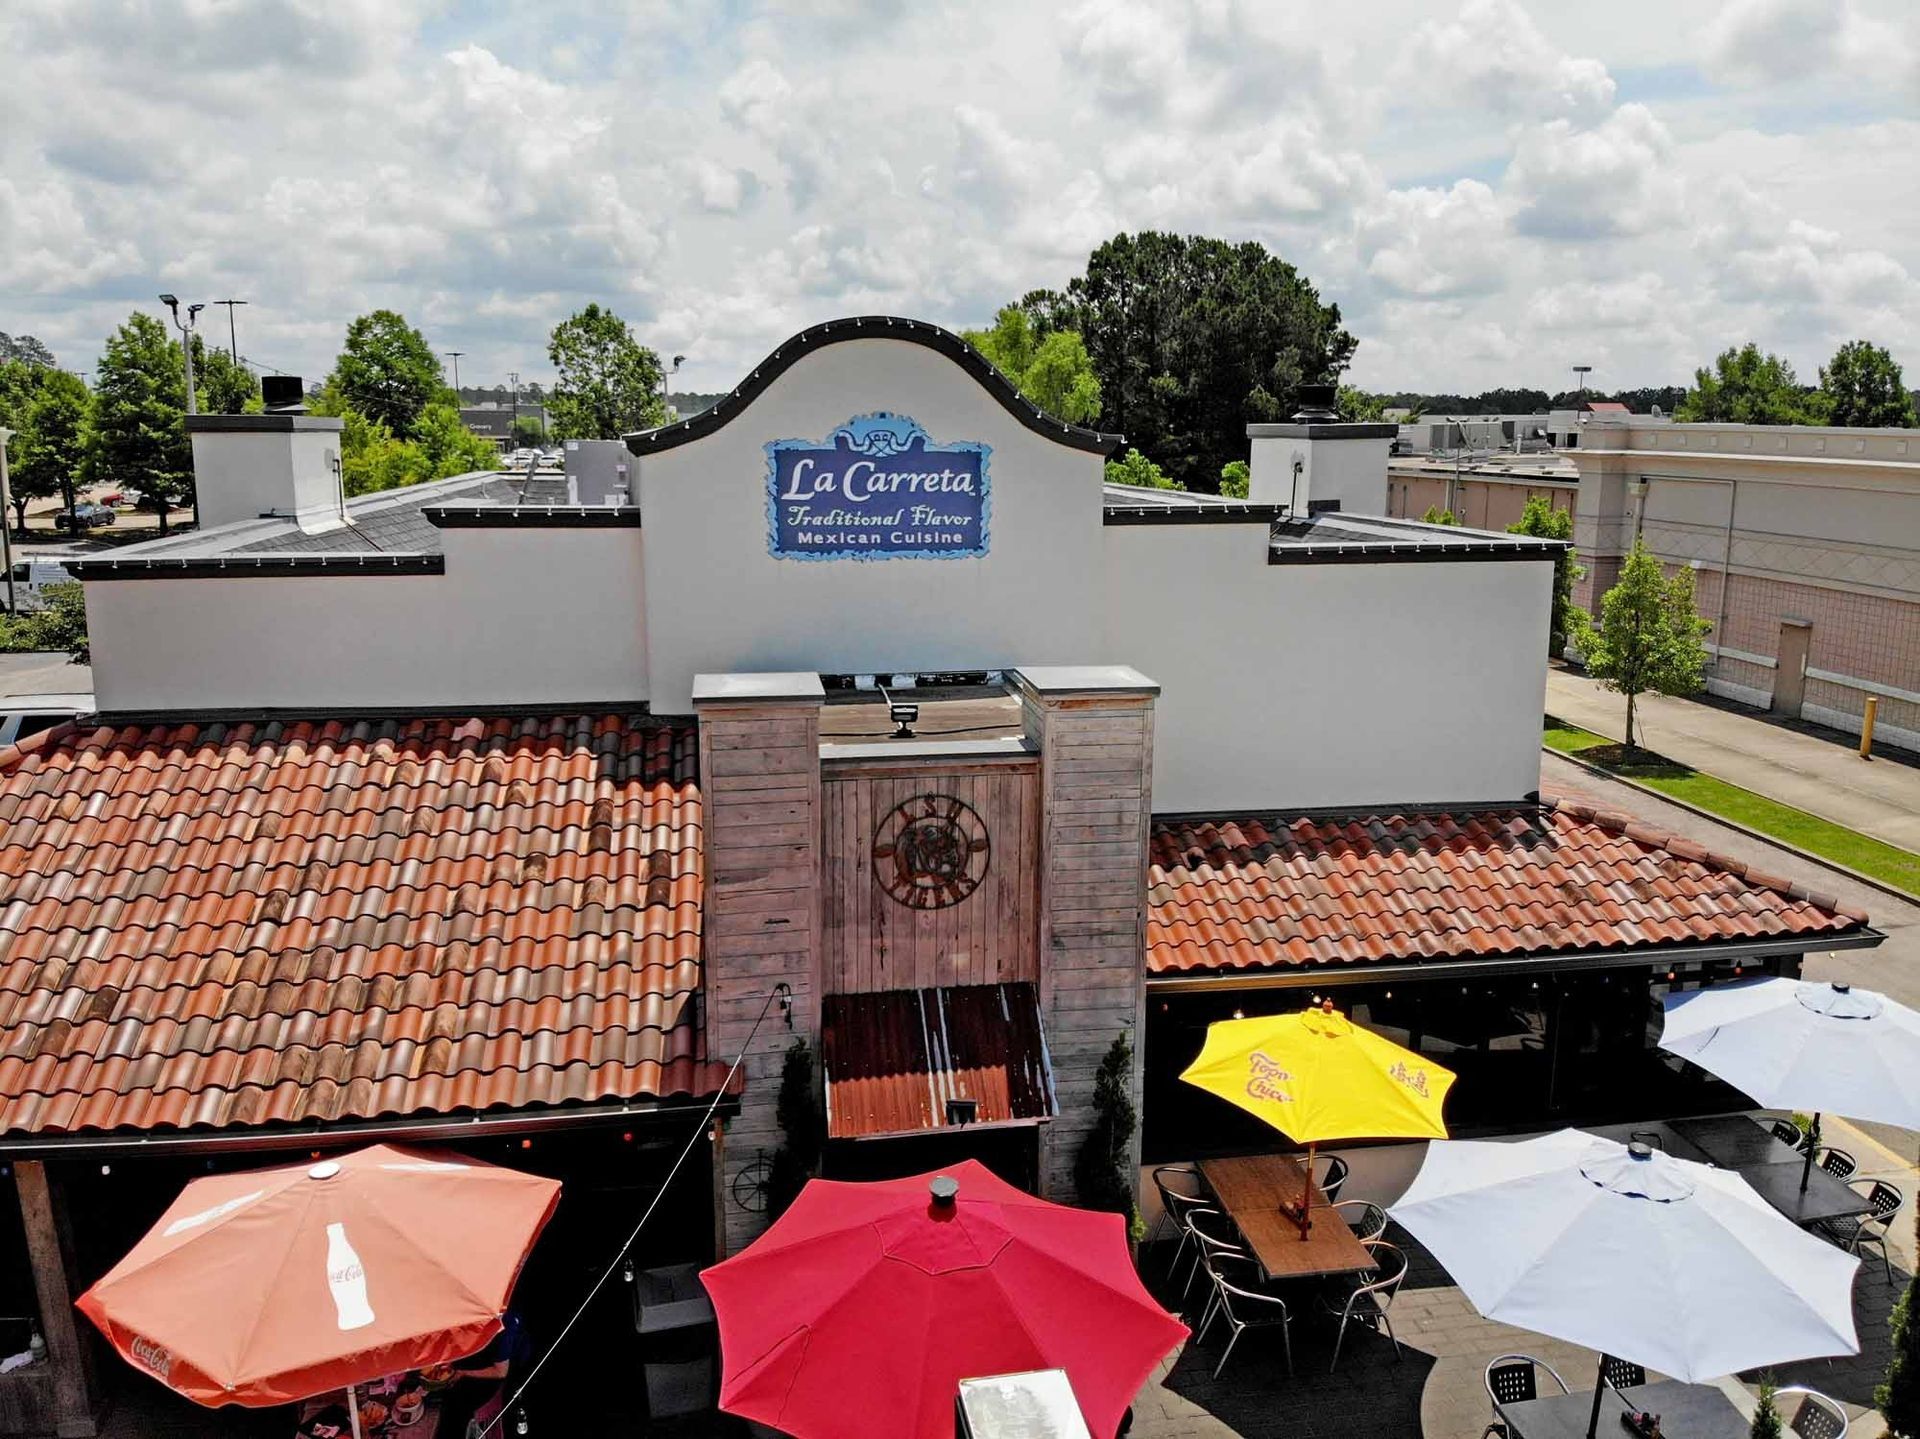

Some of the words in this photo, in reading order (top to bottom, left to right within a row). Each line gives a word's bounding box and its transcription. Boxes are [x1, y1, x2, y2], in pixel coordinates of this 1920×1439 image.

[781, 459, 837, 500] La
[842, 461, 974, 502] Carreta
[787, 505, 904, 526] Traditional
[910, 504, 972, 526] Flavor
[798, 532, 881, 544] Mexican
[890, 531, 963, 544] Cuisine
[898, 796, 965, 823] LSU
